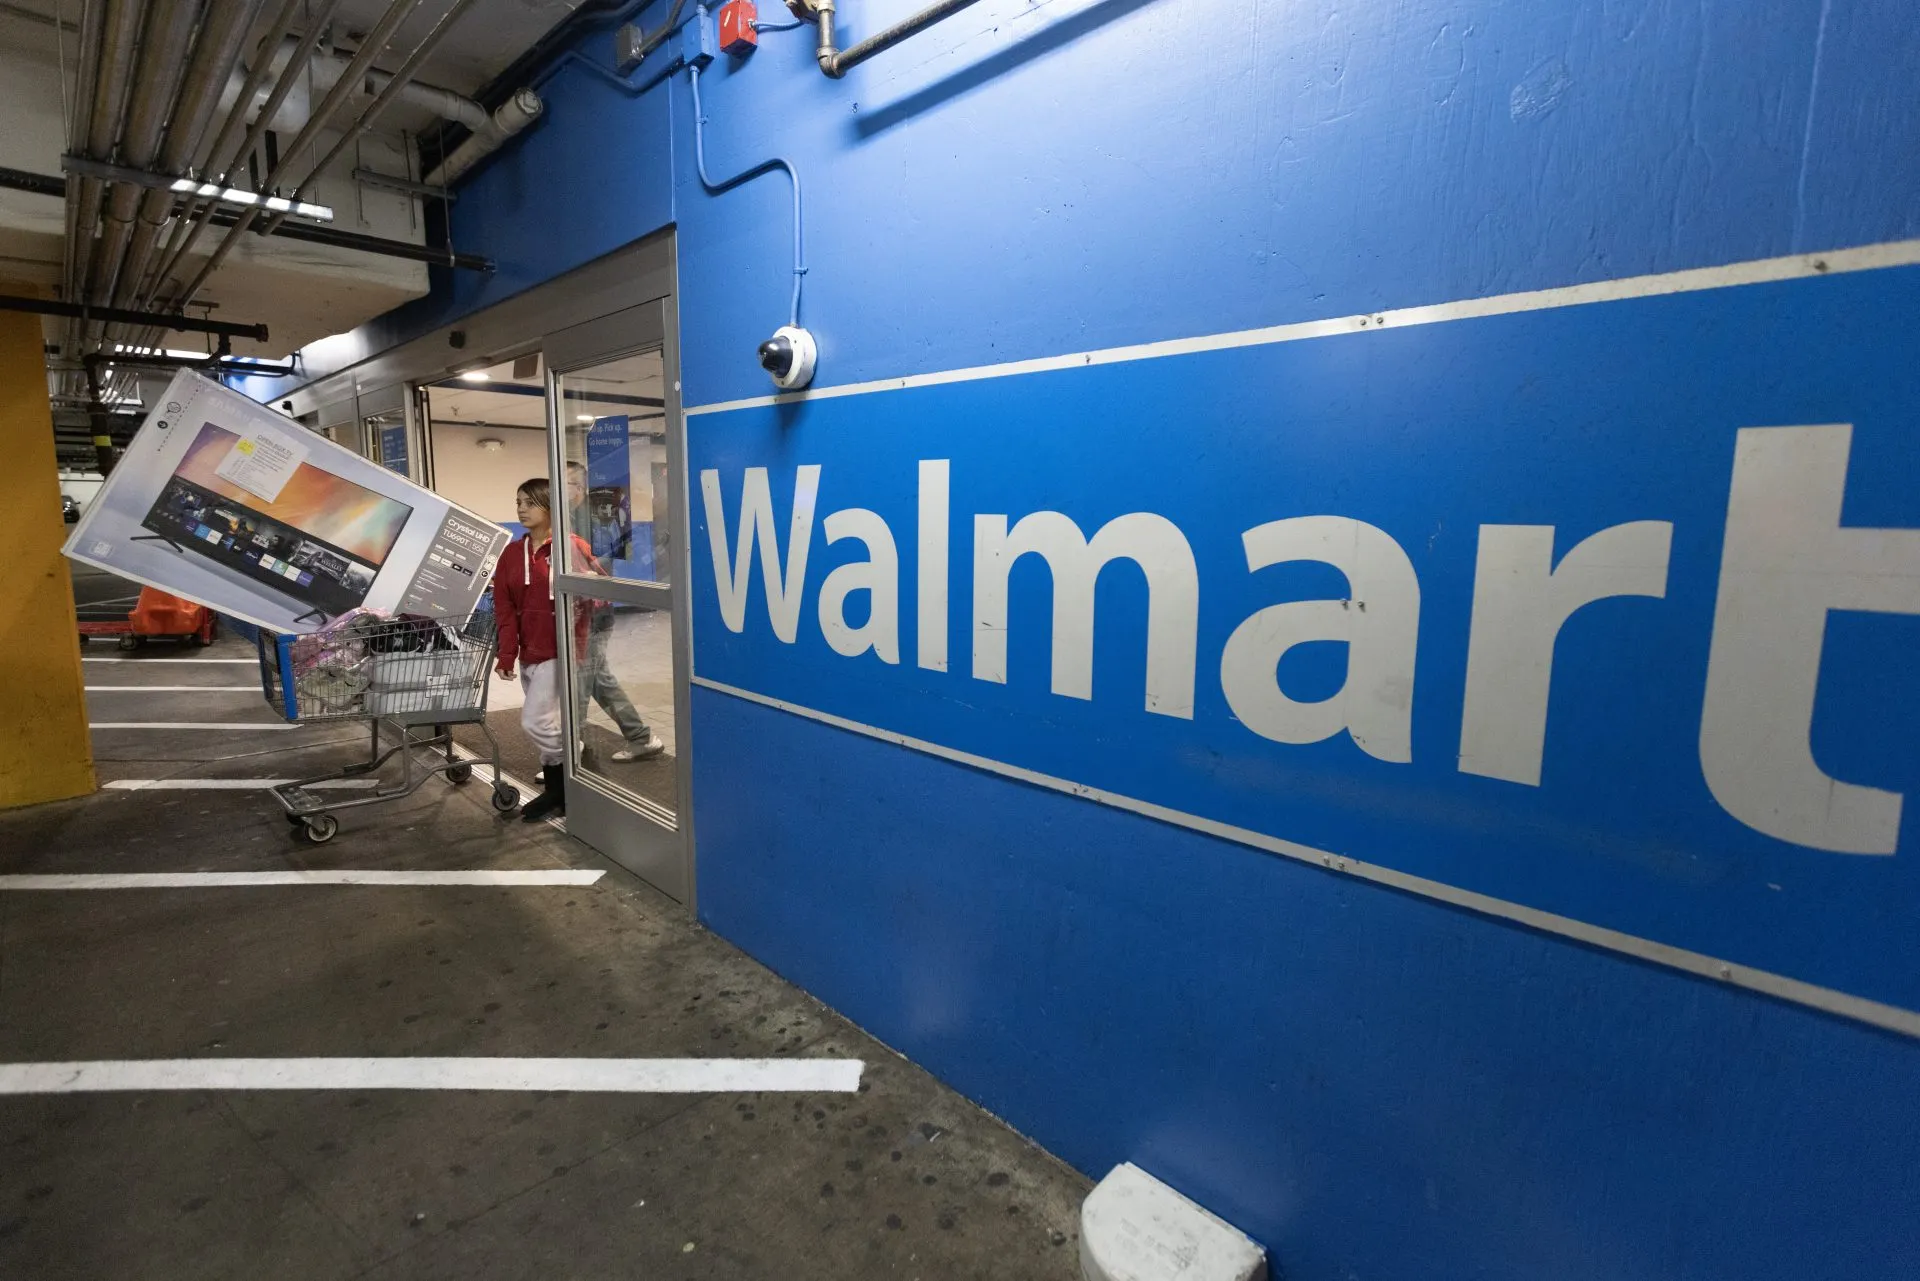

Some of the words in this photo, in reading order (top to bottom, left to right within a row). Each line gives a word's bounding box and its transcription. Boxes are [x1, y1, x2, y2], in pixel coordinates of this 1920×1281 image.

[443, 529, 469, 546] TU690T
[447, 518, 475, 537] Crystal
[475, 529, 490, 543] UHD
[700, 423, 1920, 856] Walmart
